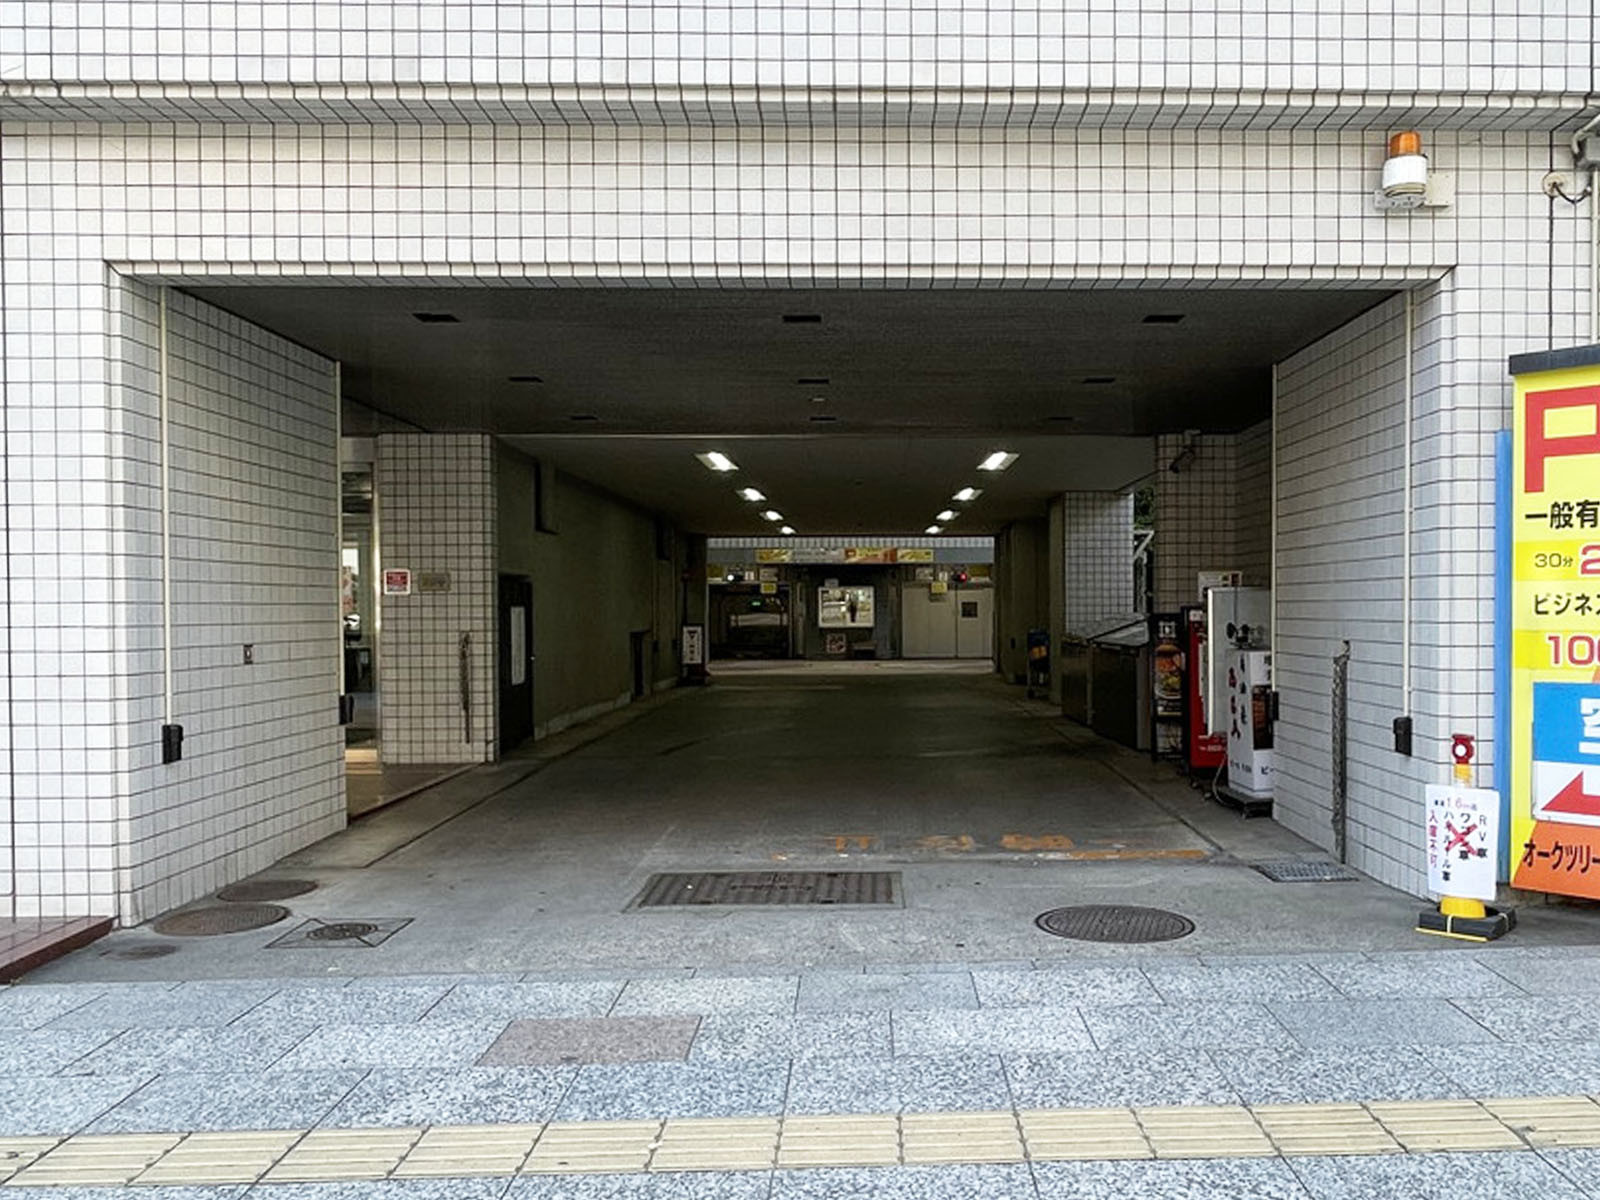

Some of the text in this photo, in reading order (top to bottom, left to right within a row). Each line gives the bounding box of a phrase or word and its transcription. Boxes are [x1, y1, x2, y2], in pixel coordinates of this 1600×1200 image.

[1525, 385, 1600, 493] P
[1525, 499, 1600, 529] 一般有
[1534, 552, 1574, 568] 30分
[1534, 592, 1600, 616] ビジネ
[1548, 635, 1600, 665] 10
